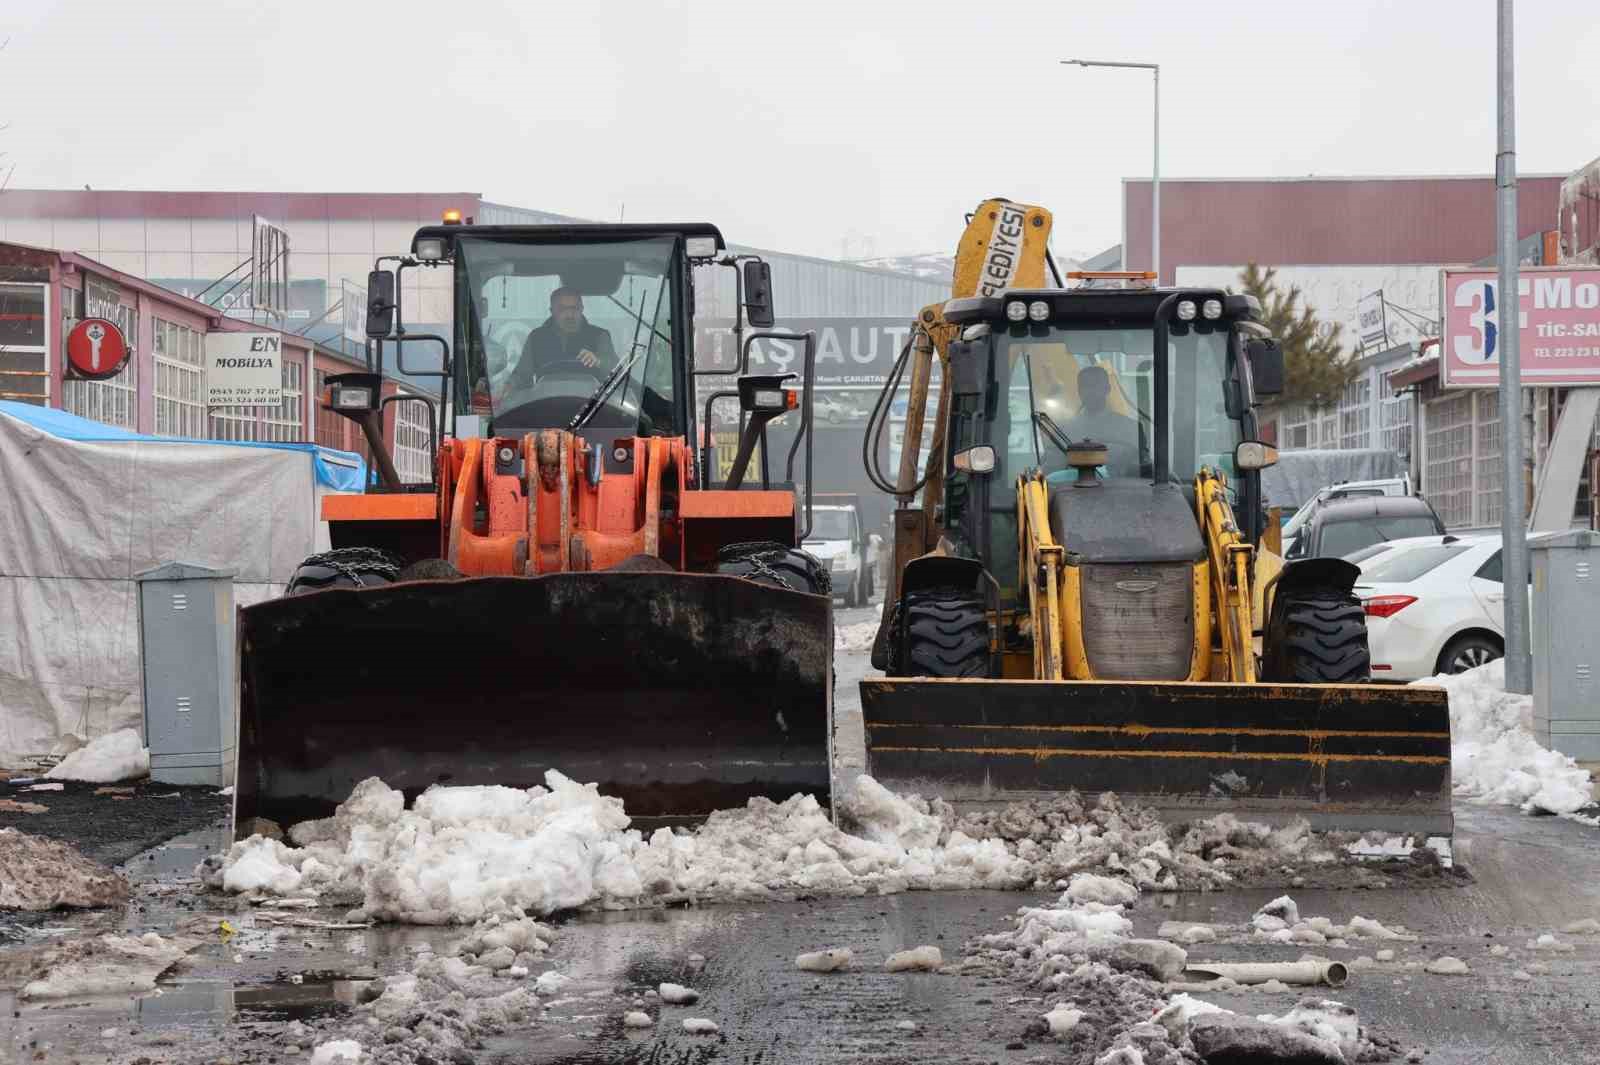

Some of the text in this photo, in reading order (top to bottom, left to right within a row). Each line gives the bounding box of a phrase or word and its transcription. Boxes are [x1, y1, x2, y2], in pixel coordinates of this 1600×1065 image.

[1535, 322, 1600, 337] TİC.SA
[250, 336, 279, 352] EN
[815, 327, 913, 364] AUT
